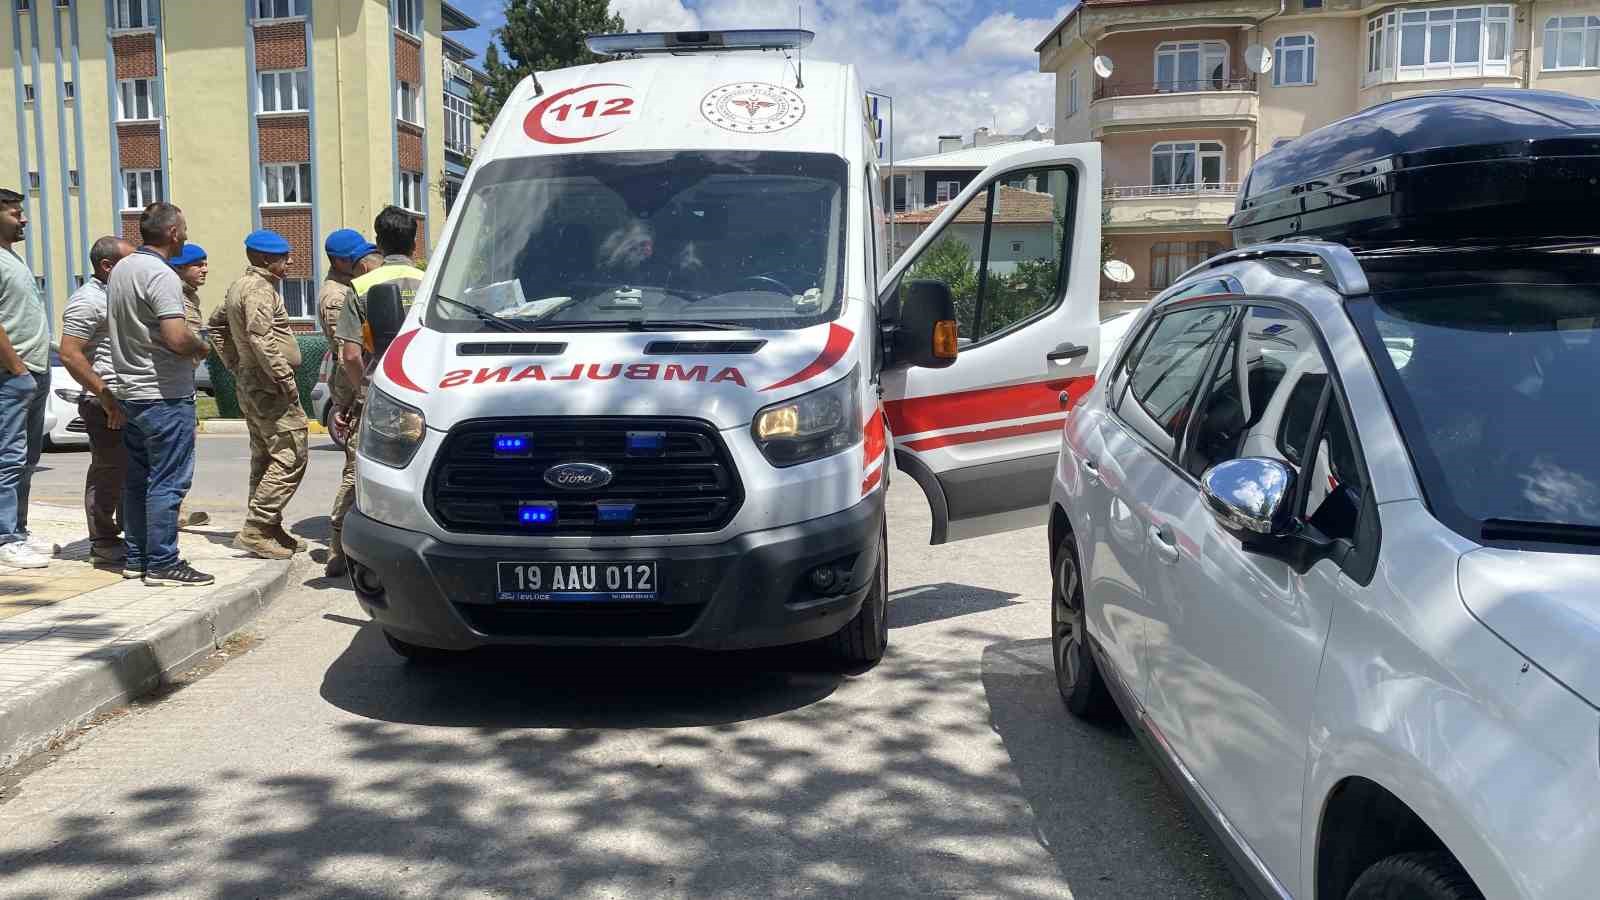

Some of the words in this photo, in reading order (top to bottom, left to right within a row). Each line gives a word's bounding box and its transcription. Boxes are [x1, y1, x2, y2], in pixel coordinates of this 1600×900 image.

[550, 97, 634, 122] 112
[558, 471, 592, 484] Ford
[514, 566, 542, 590] 19
[552, 565, 596, 590] AAU
[606, 564, 651, 590] 012
